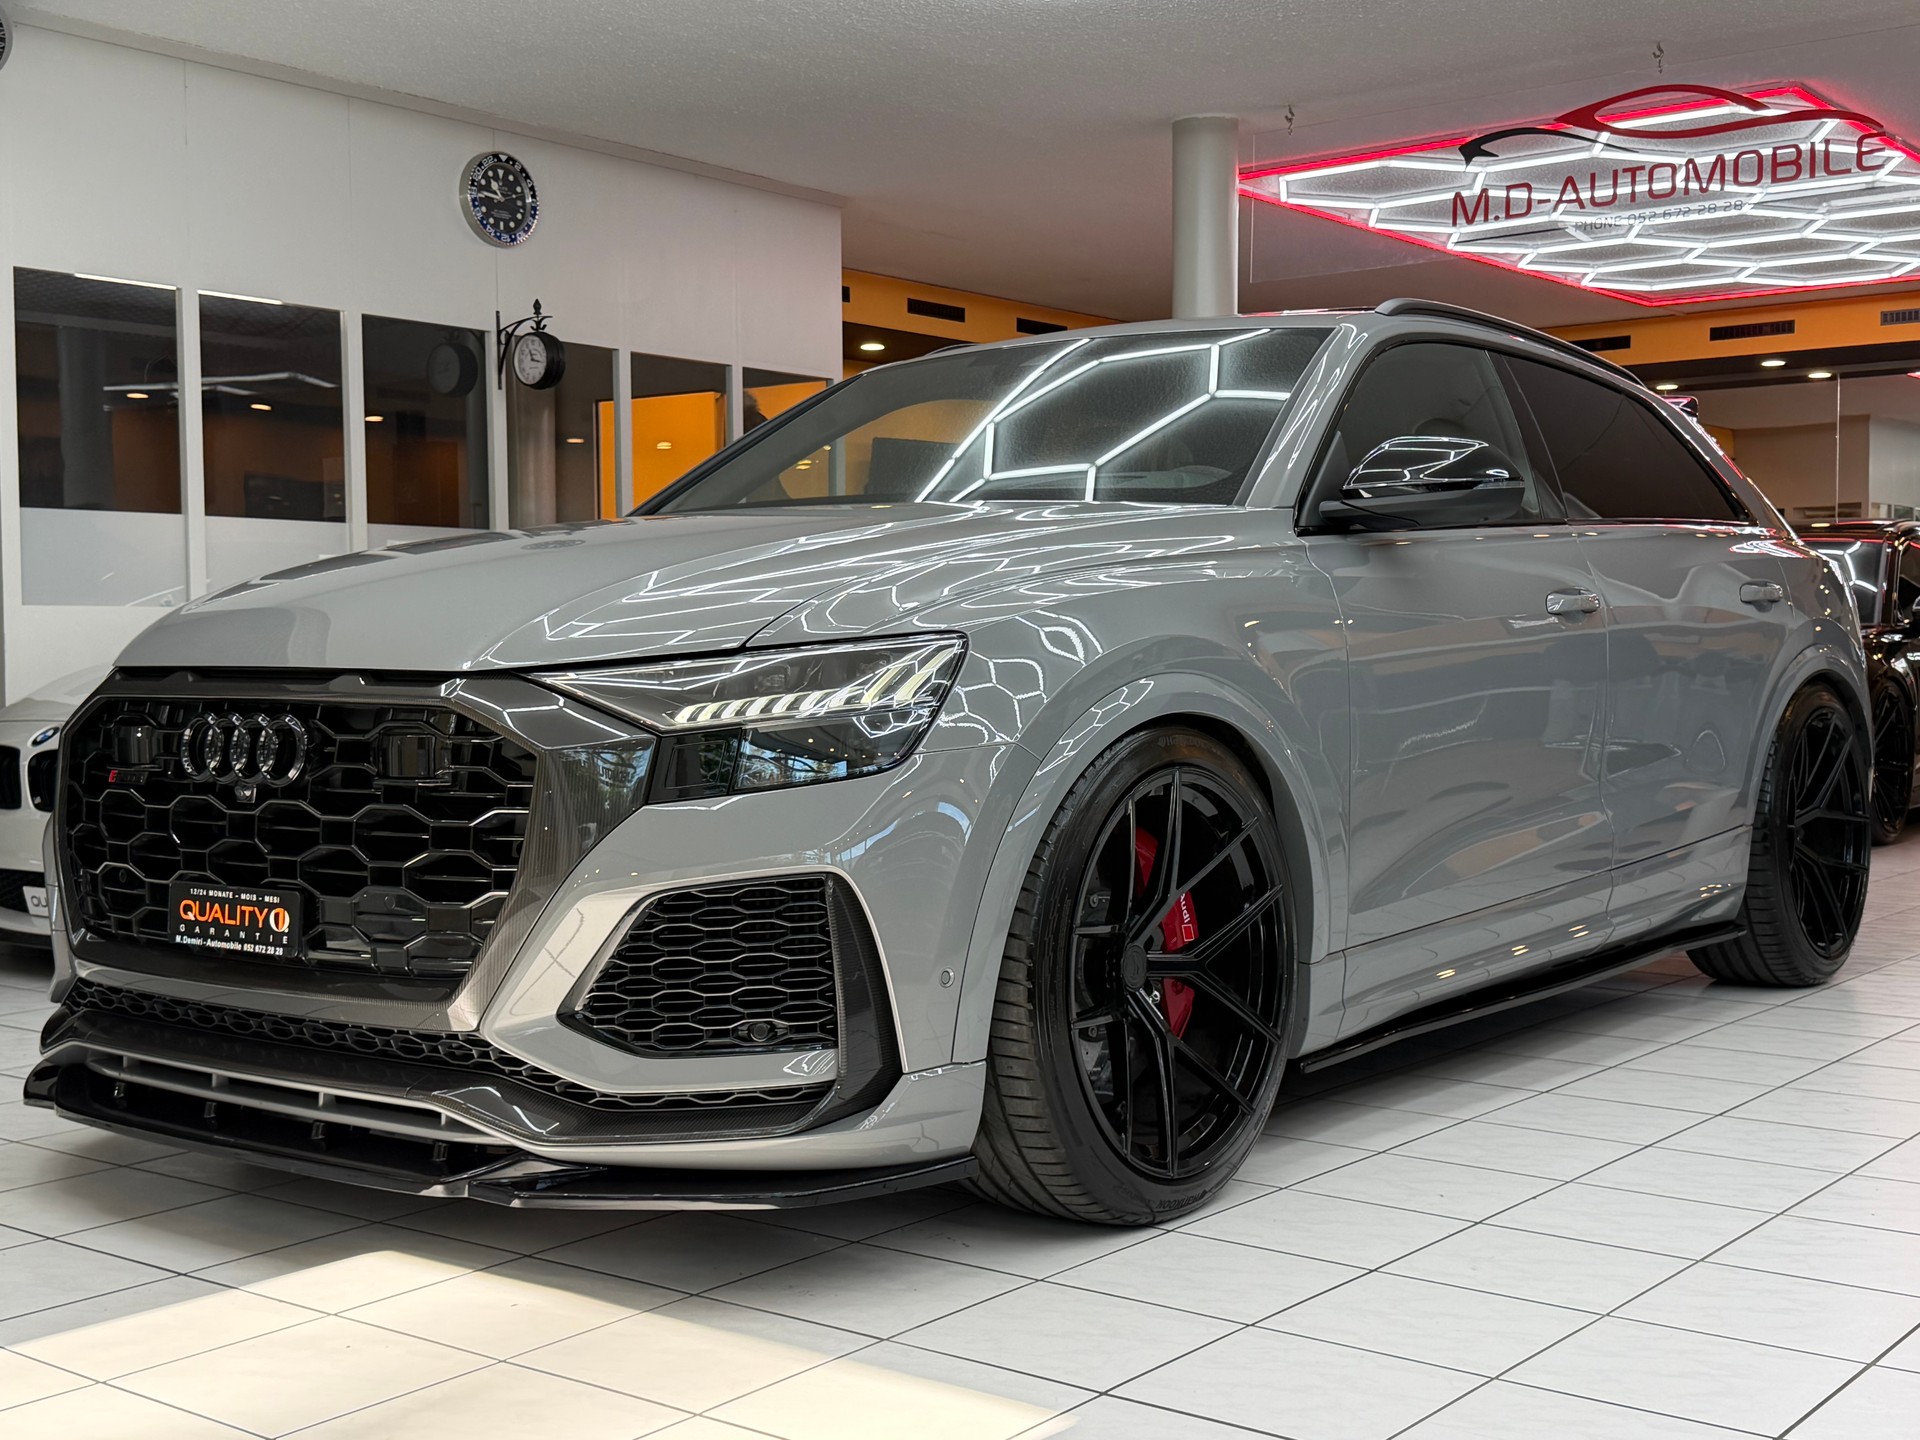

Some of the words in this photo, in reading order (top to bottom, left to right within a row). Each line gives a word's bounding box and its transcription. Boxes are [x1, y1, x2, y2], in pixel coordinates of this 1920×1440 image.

[1574, 215, 1622, 232] PHONE
[1627, 210, 1656, 226] 052
[1662, 206, 1691, 220] 672
[1697, 203, 1717, 216] 28
[1723, 199, 1743, 212] 28
[190, 888, 207, 896] 12/24
[209, 890, 234, 899] MONATE
[241, 893, 257, 902] MOIS
[264, 895, 280, 904] MESI
[180, 899, 268, 928] QUALITY
[180, 924, 288, 944] GARANTIE
[243, 943, 254, 952] 052
[255, 944, 266, 954] 672
[266, 945, 275, 955] 28
[275, 947, 284, 956] 28
